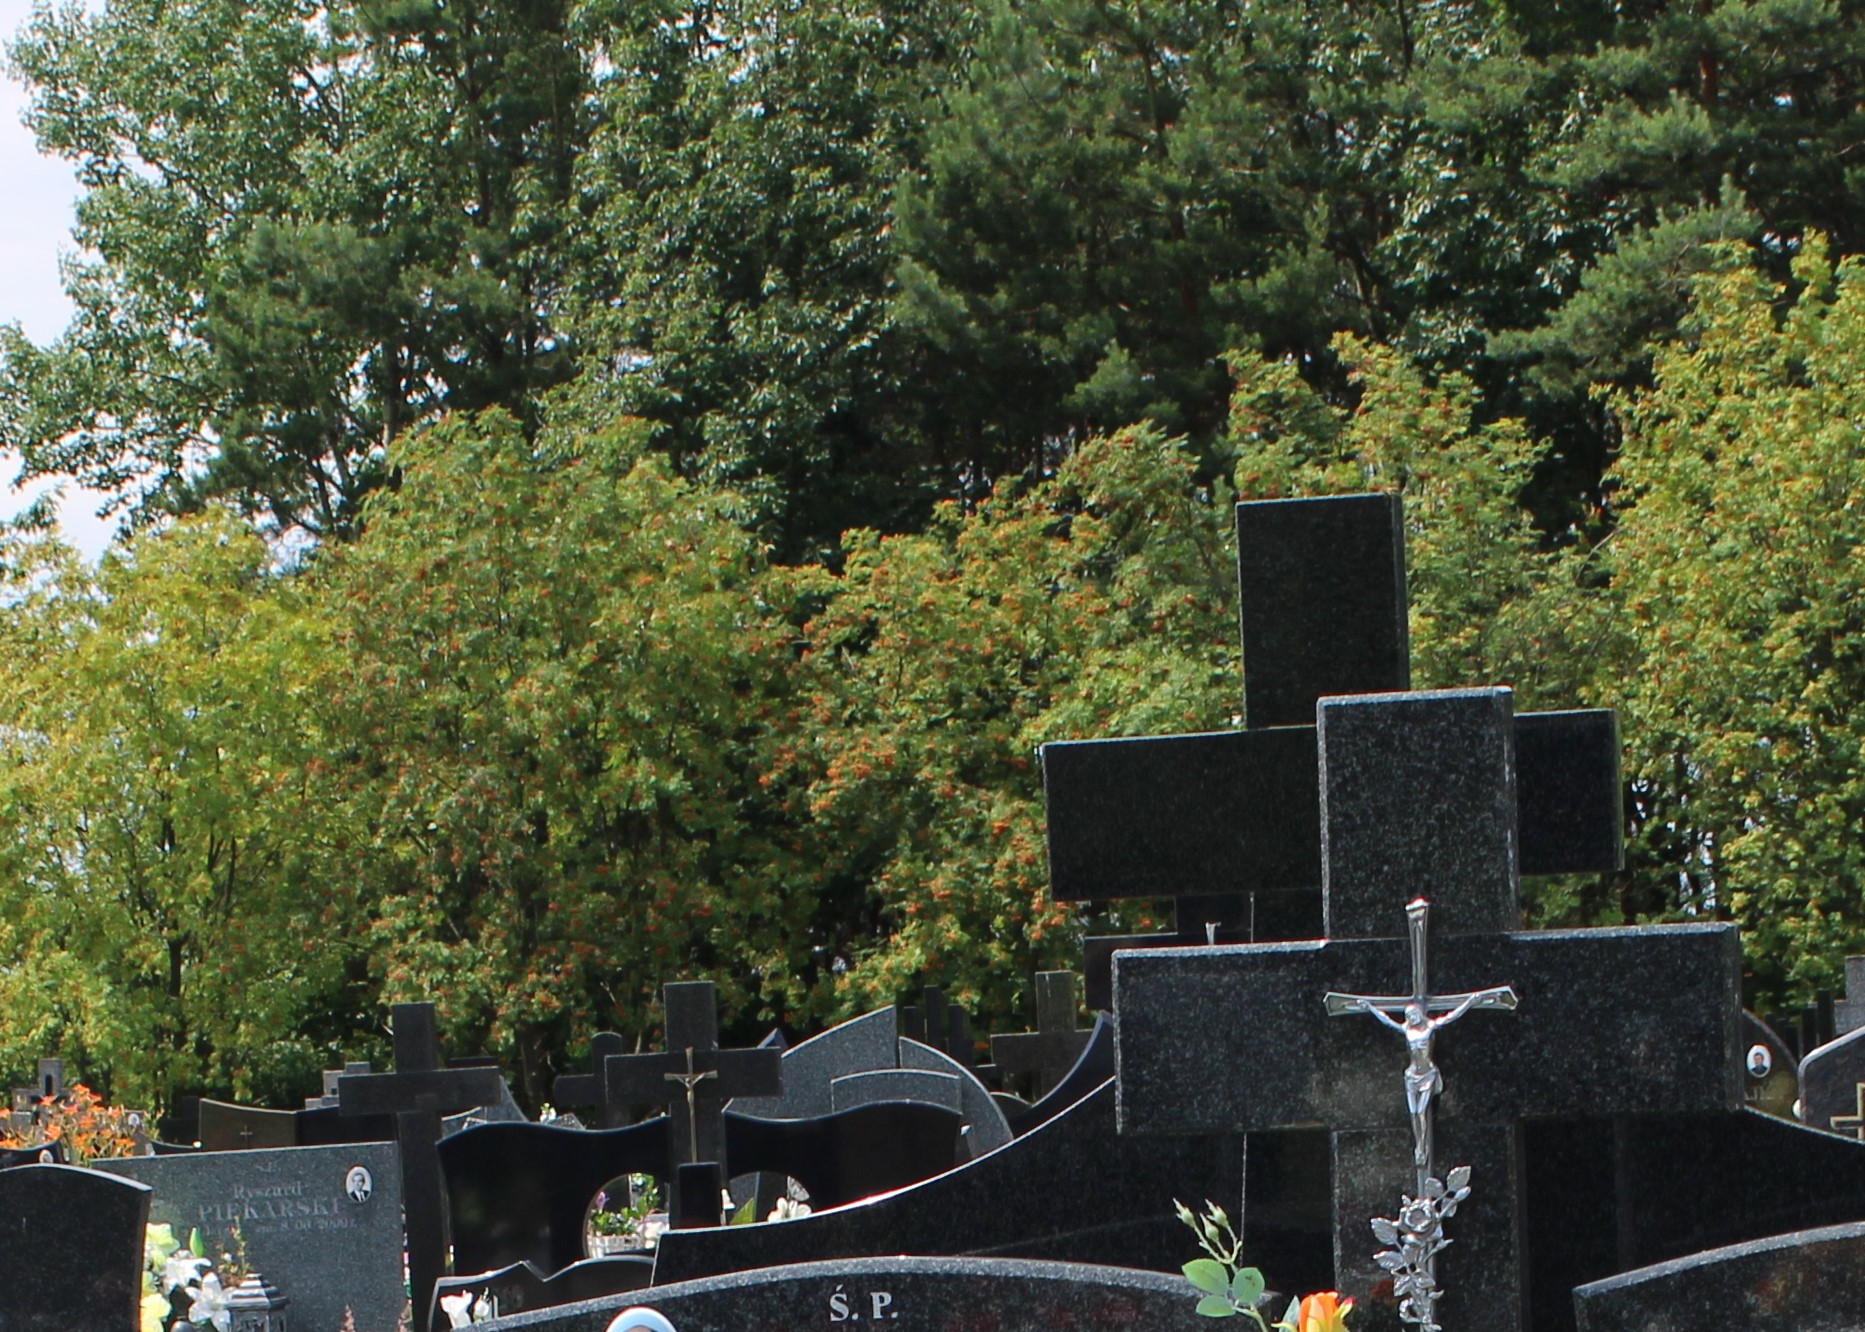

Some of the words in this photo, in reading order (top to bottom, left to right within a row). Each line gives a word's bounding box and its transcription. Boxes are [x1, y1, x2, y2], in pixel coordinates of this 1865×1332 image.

[199, 1198, 339, 1221] PIEKARSKI
[830, 1284, 858, 1321] Ś.
[871, 1292, 898, 1319] P.
